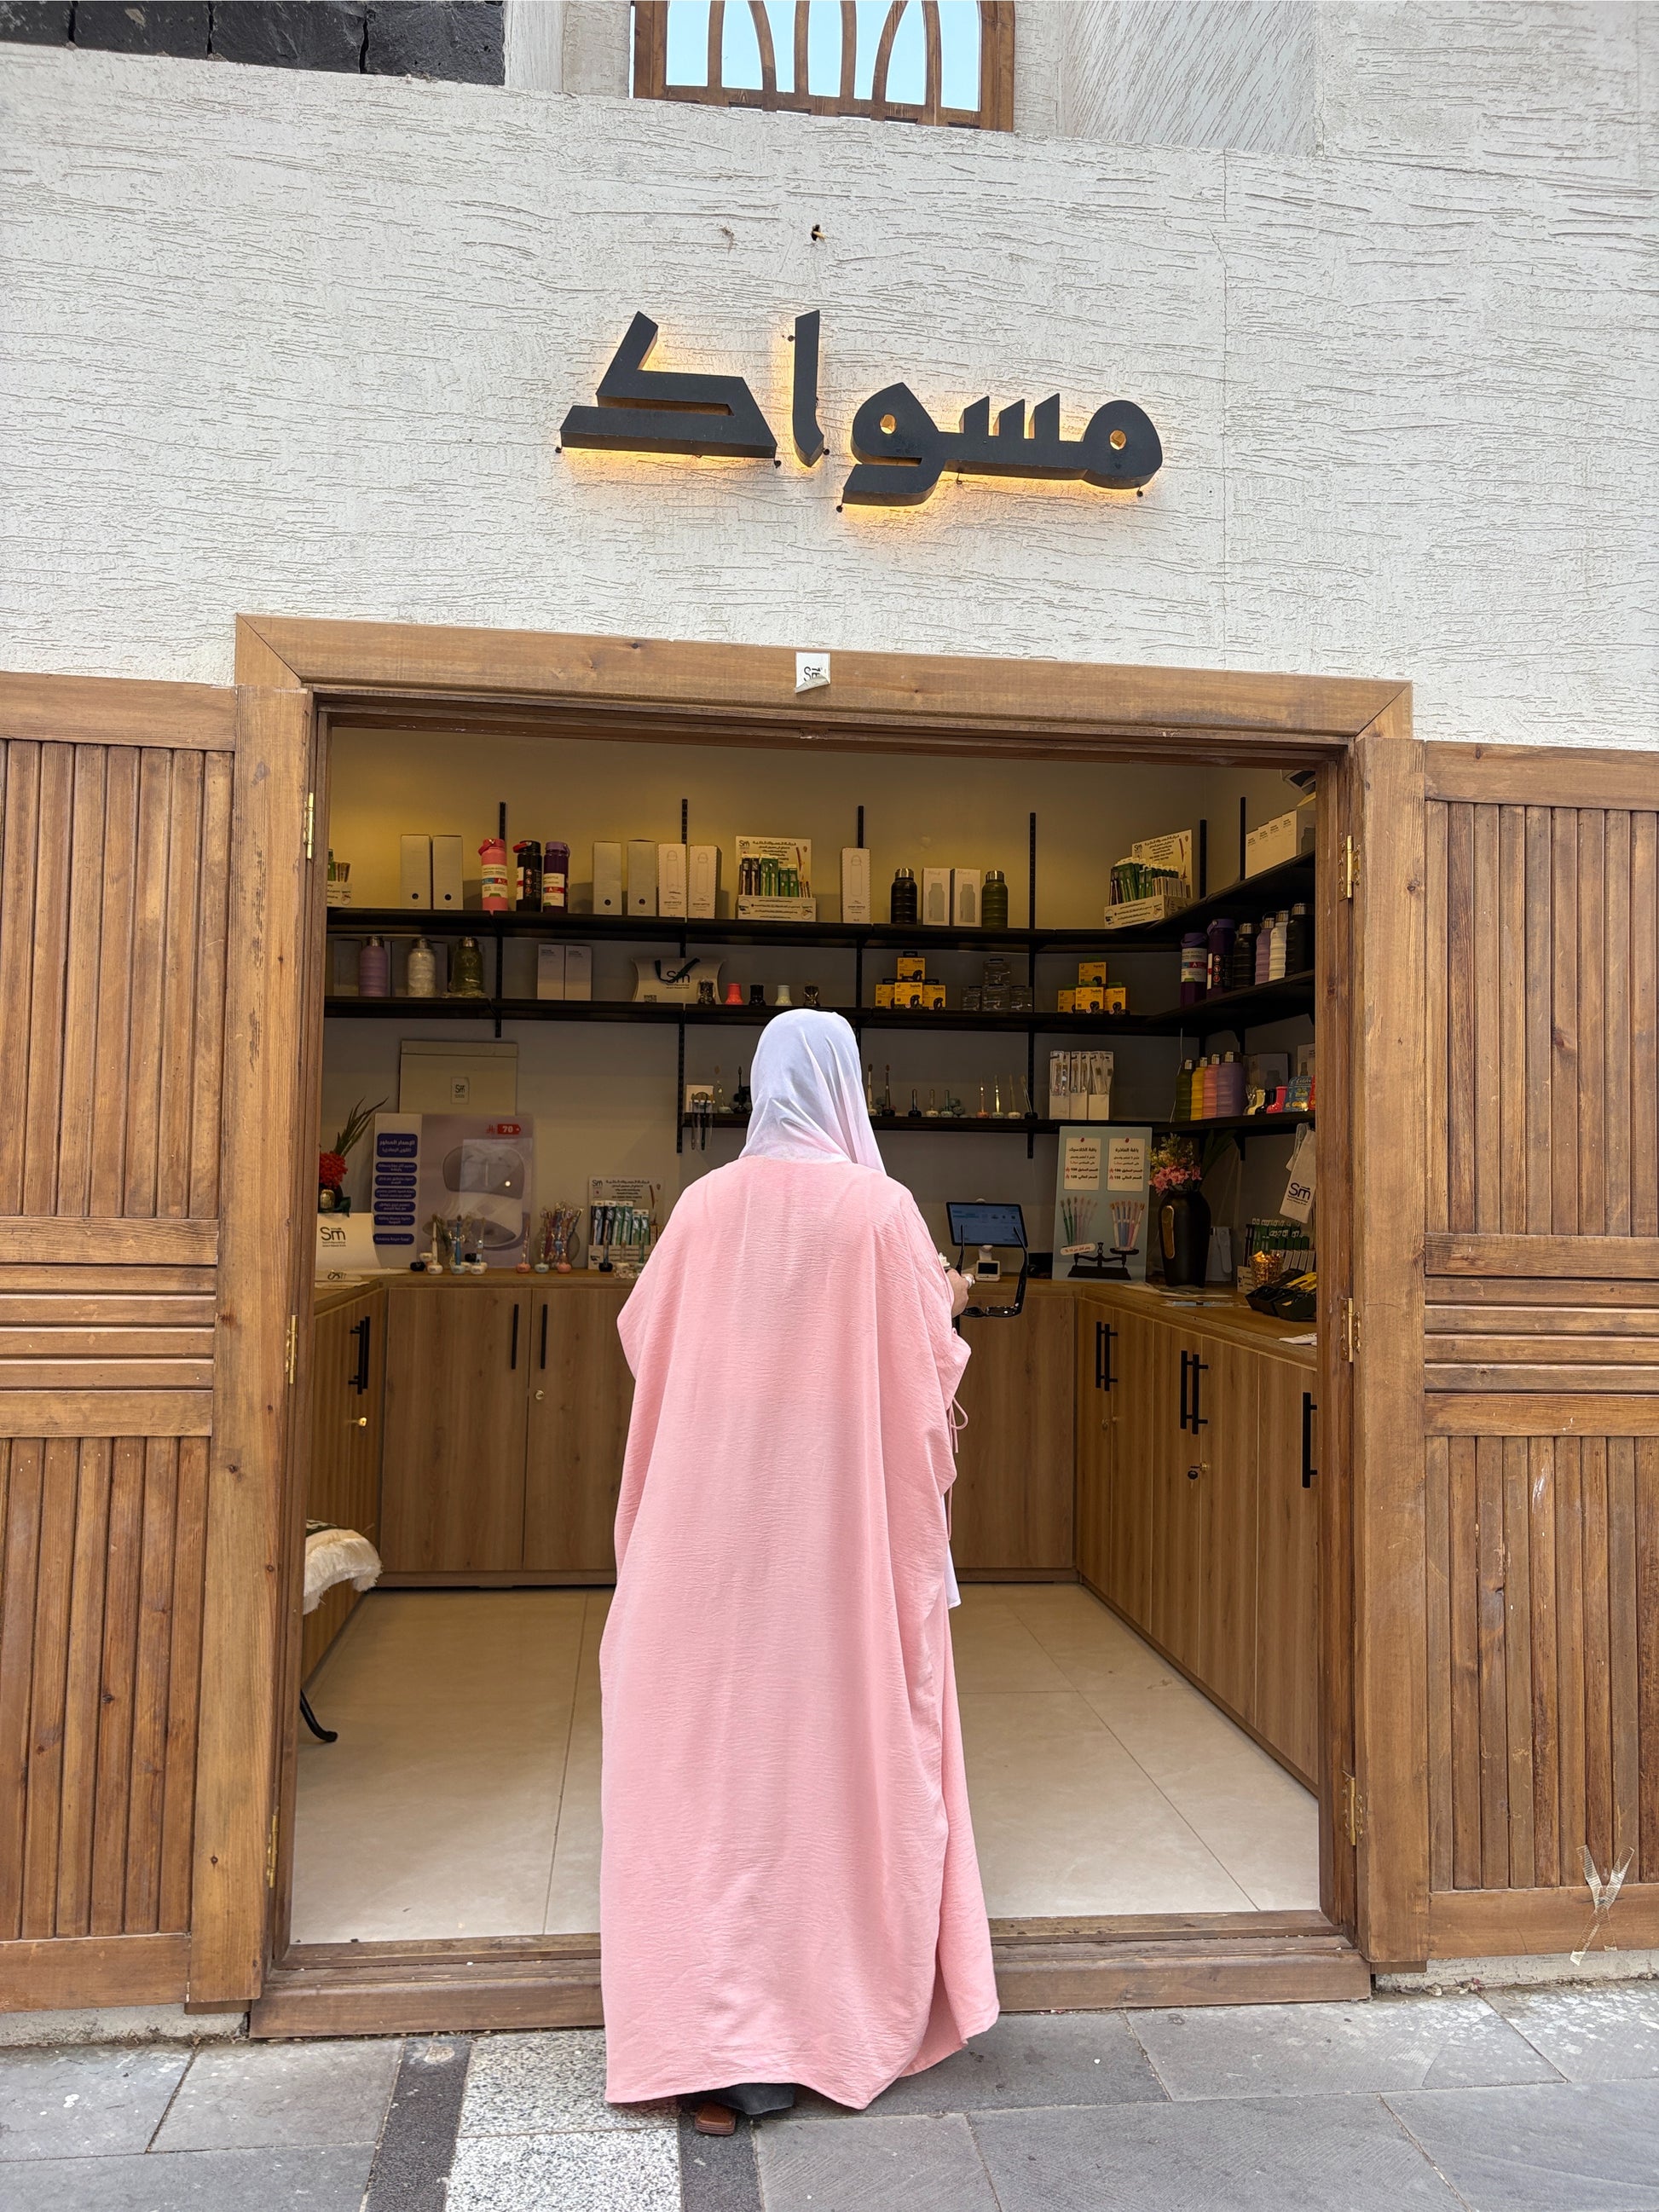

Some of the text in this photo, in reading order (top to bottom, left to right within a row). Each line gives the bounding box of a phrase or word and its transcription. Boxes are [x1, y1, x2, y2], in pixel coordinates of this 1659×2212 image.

[559, 310, 1163, 506] مسواك
[1288, 1182, 1311, 1200] Sm
[320, 1227, 346, 1241] Sm
